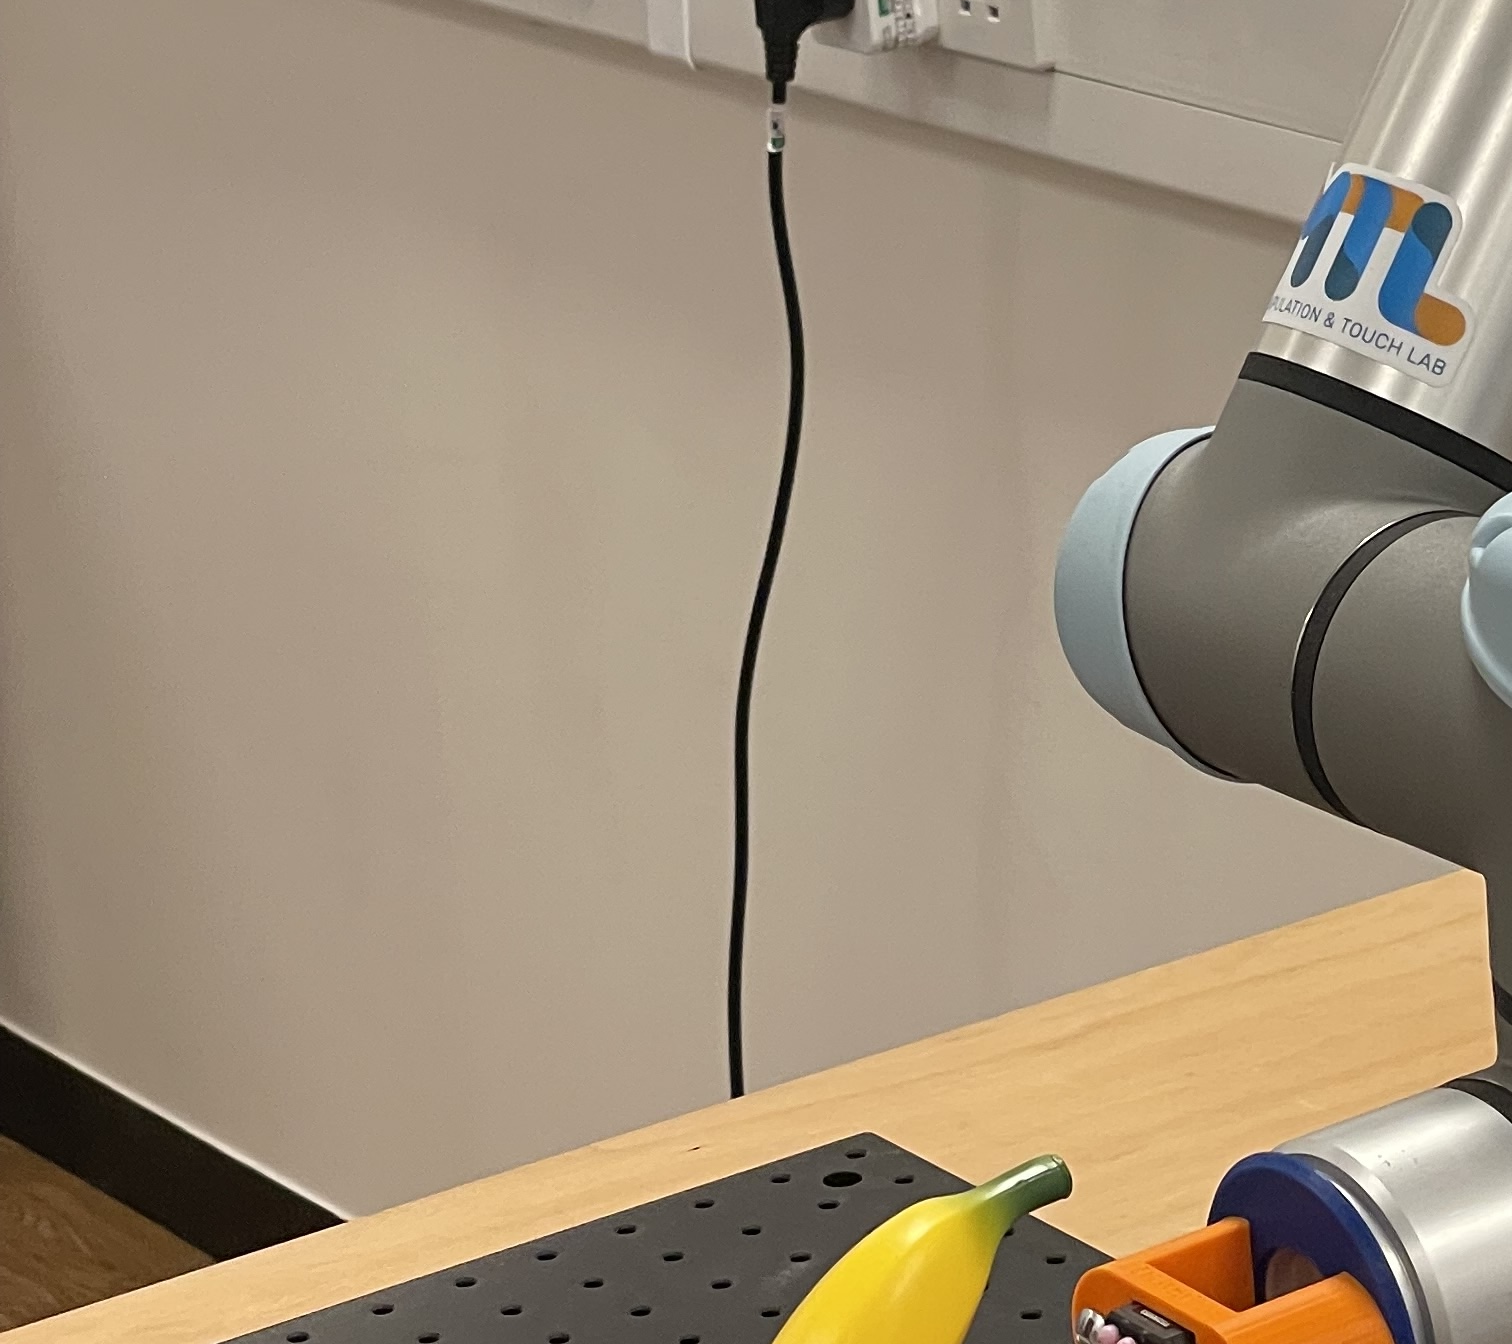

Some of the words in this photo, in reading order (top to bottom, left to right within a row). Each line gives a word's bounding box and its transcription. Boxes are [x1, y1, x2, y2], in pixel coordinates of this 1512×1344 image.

[1323, 312, 1335, 328] &
[1341, 317, 1403, 356] TOUCH
[1406, 346, 1447, 375] LAB
